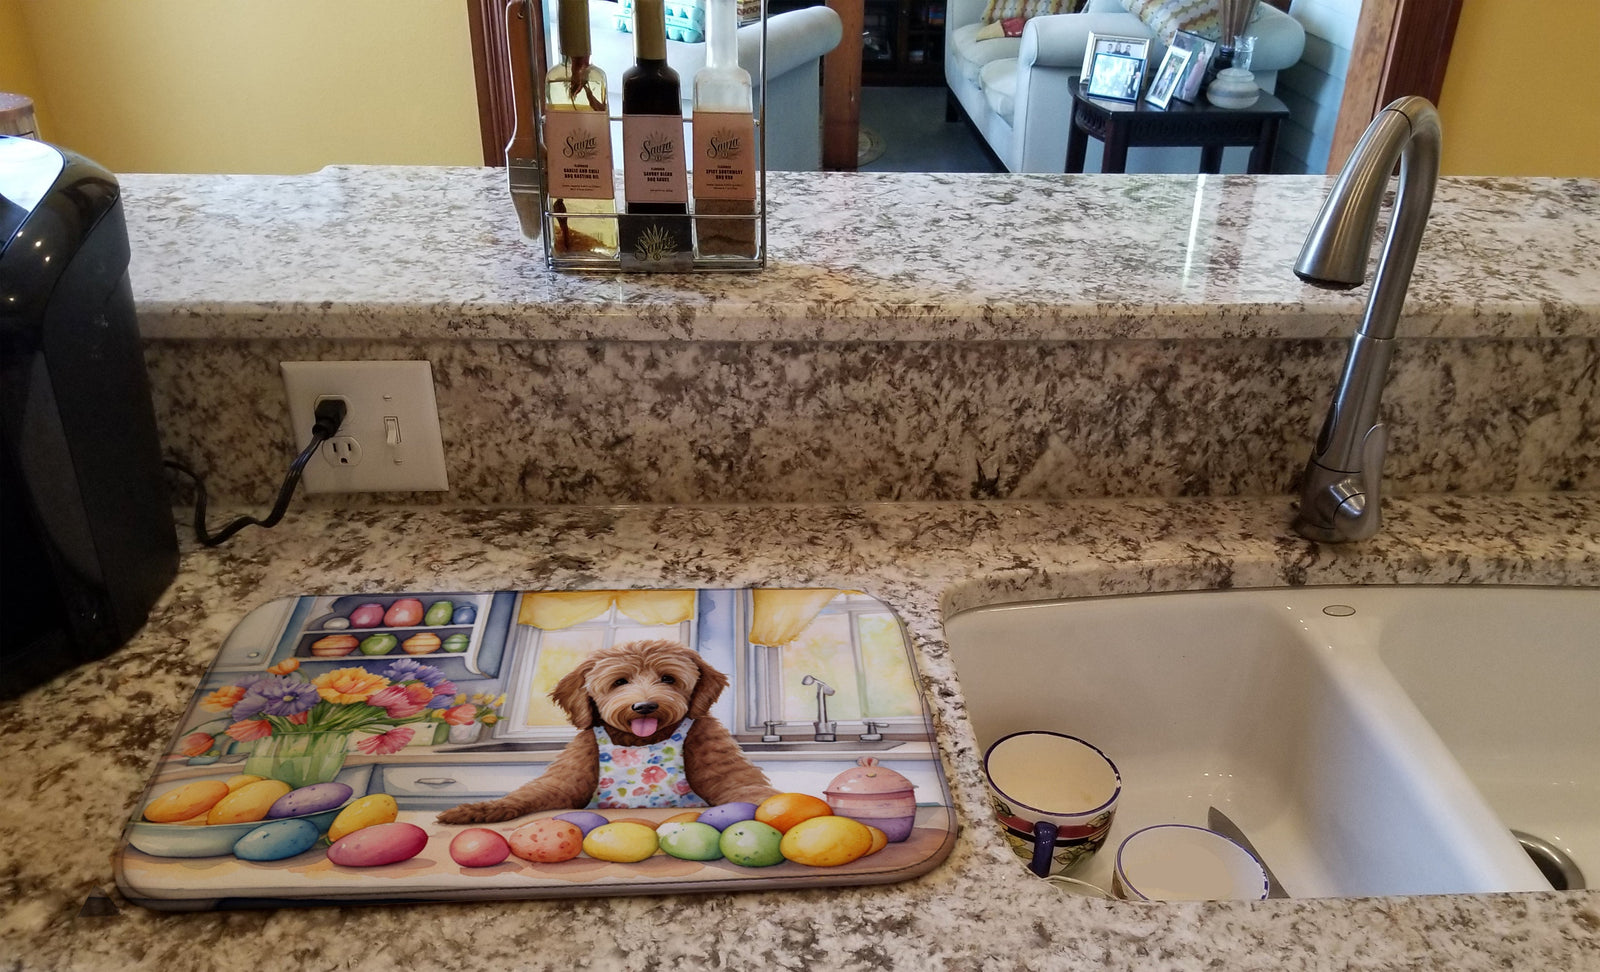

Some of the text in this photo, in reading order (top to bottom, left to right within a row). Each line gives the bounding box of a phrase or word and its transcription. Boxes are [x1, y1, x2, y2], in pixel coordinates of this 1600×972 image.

[562, 136, 597, 158] Sauza
[640, 140, 674, 162] Sauza
[707, 137, 741, 159] Sauza
